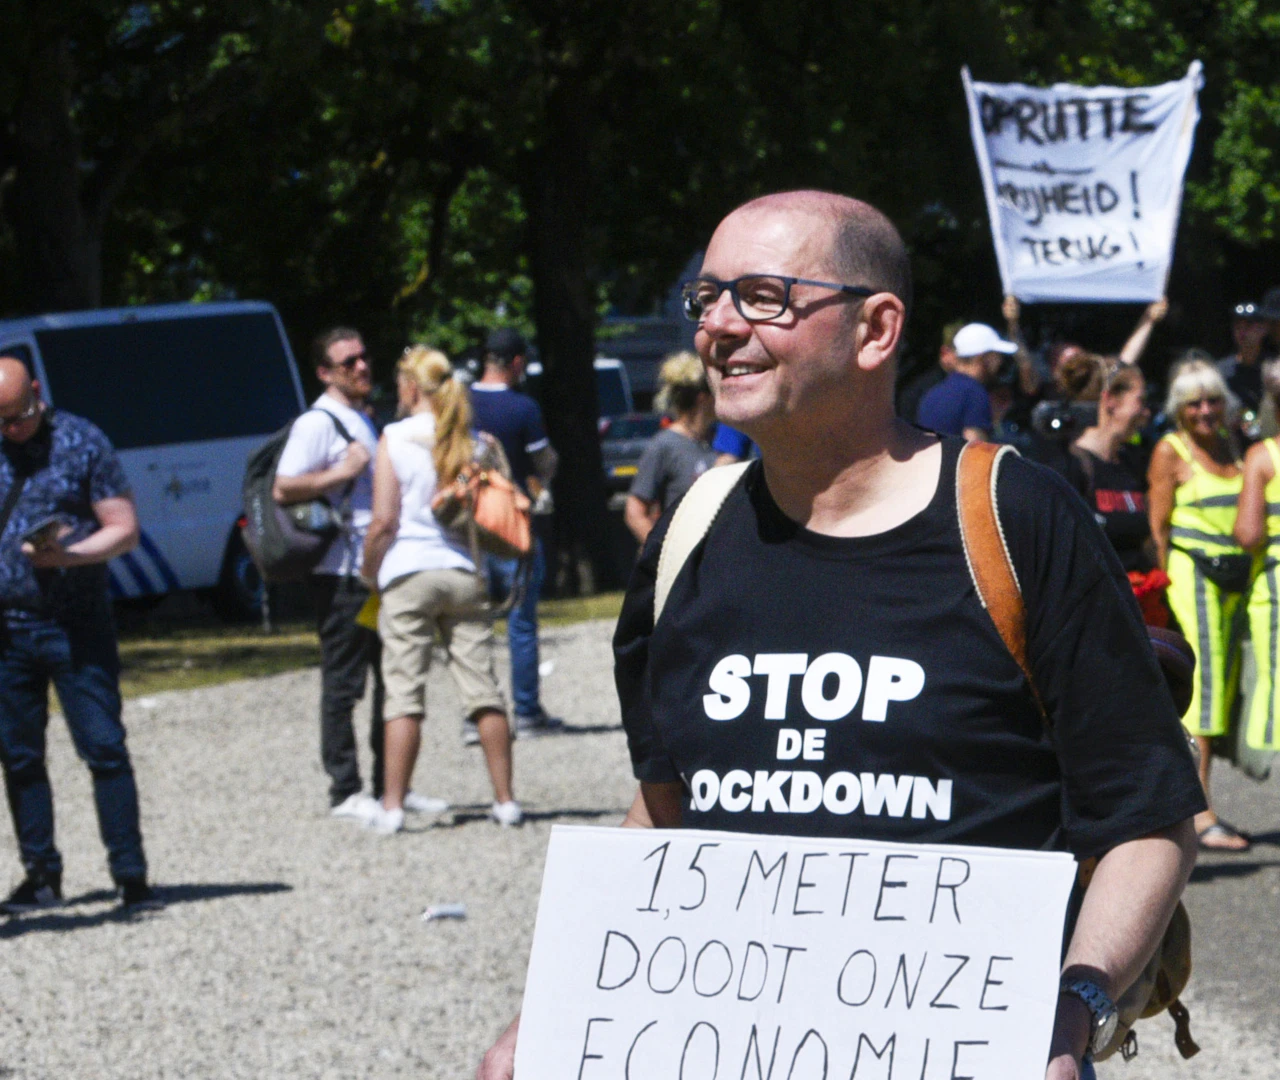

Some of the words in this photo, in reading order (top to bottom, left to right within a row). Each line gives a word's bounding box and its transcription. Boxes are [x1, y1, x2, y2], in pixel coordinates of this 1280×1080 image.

[703, 653, 925, 721] STOP
[777, 729, 826, 760] DE
[680, 769, 953, 821] OCKDOWN
[636, 841, 720, 919] 1,5
[736, 849, 971, 924] METER
[597, 930, 807, 1004] DOODT
[837, 949, 1014, 1011] ONZE
